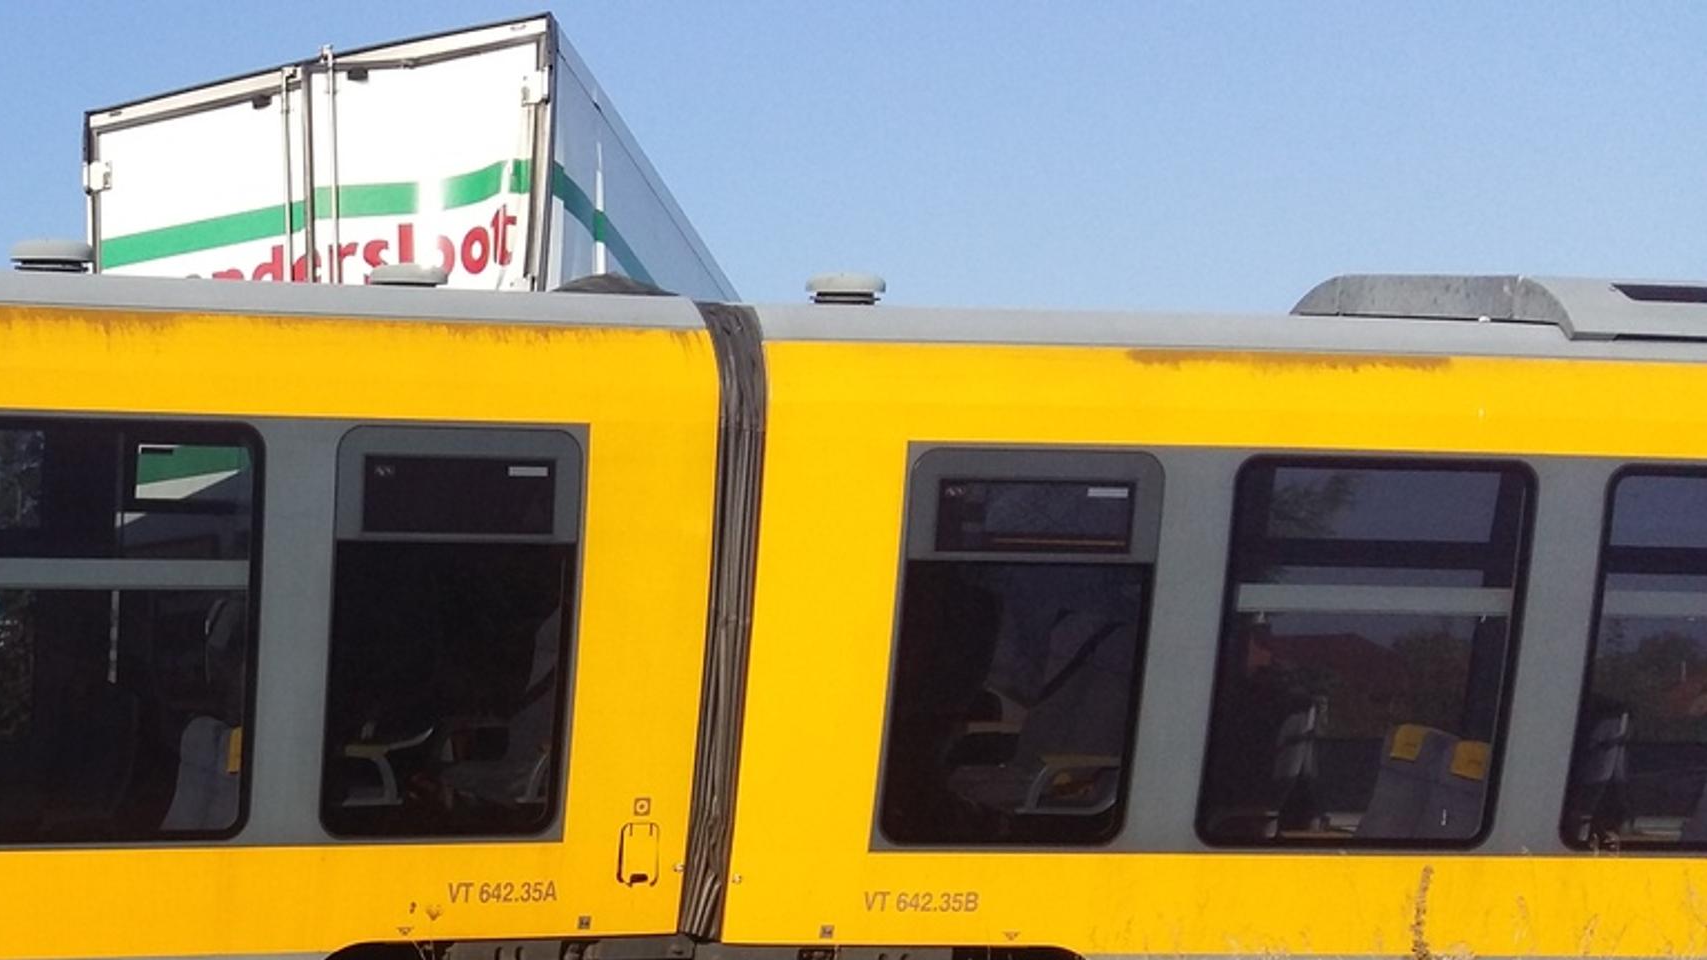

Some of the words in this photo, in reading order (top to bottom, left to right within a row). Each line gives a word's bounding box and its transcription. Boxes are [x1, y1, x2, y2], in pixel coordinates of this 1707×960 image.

[212, 204, 517, 285] derslot
[448, 882, 474, 903] VT
[478, 880, 557, 903] 642.35A
[864, 891, 890, 912] VT
[895, 892, 979, 912] 642.35B
